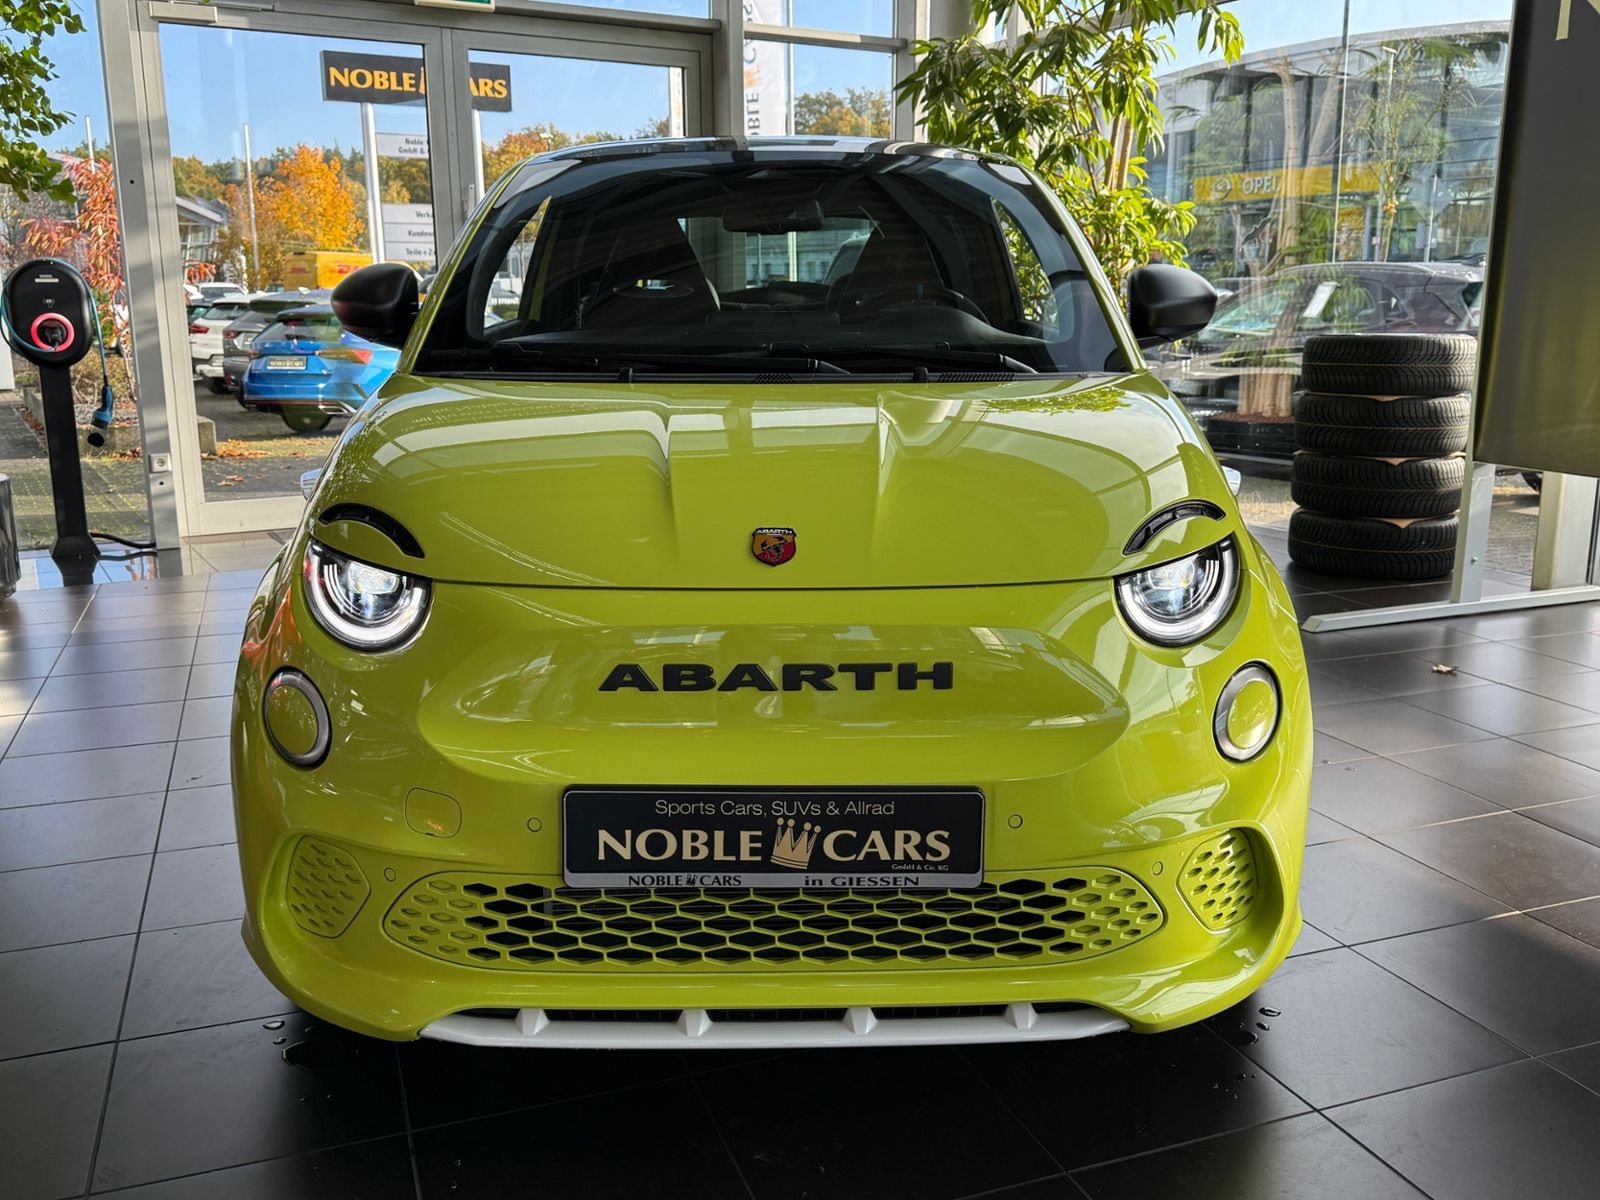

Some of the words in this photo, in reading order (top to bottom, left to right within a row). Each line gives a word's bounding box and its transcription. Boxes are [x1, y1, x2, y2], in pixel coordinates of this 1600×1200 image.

[329, 66, 416, 92] NOBLE
[469, 77, 508, 98] ARS
[1243, 175, 1281, 195] OPEL
[598, 661, 954, 691] ABARTH
[655, 800, 716, 817] Sports
[720, 800, 767, 817] Cars,
[771, 801, 821, 816] SUVs
[826, 801, 840, 816] &
[844, 801, 895, 816] Allrad
[597, 828, 763, 861] NOBLE
[822, 829, 951, 862] CARS
[628, 875, 683, 886] NOBLE
[699, 875, 742, 886] CARS
[804, 875, 823, 886] in
[830, 876, 919, 887] GIESSEN
